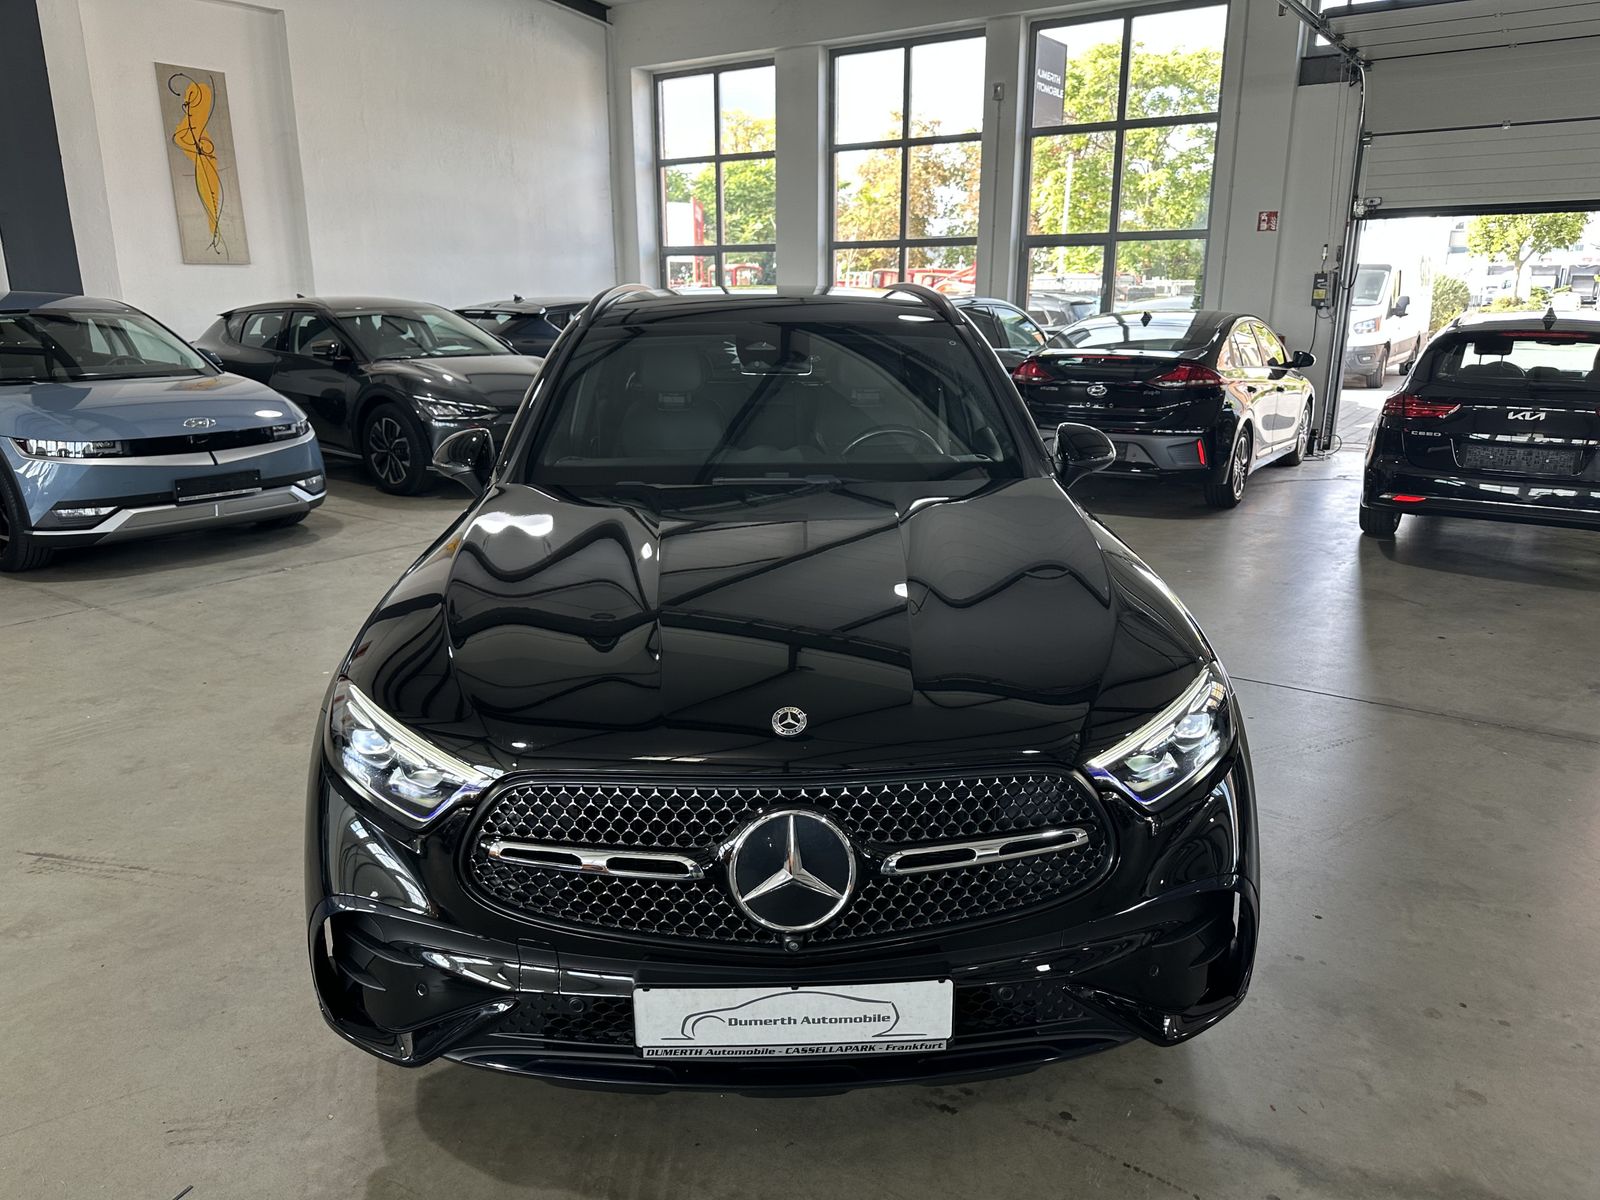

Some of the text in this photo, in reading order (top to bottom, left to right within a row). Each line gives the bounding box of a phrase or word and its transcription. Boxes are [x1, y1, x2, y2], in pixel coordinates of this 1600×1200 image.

[1037, 68, 1061, 85] UMERTH
[728, 1013, 891, 1027] Dumerth Automobile
[646, 1048, 703, 1057] DUMERTH
[705, 1047, 776, 1056] Automobile
[785, 1044, 877, 1055] CASSELLAPARK
[885, 1042, 944, 1052] Frankfurt
